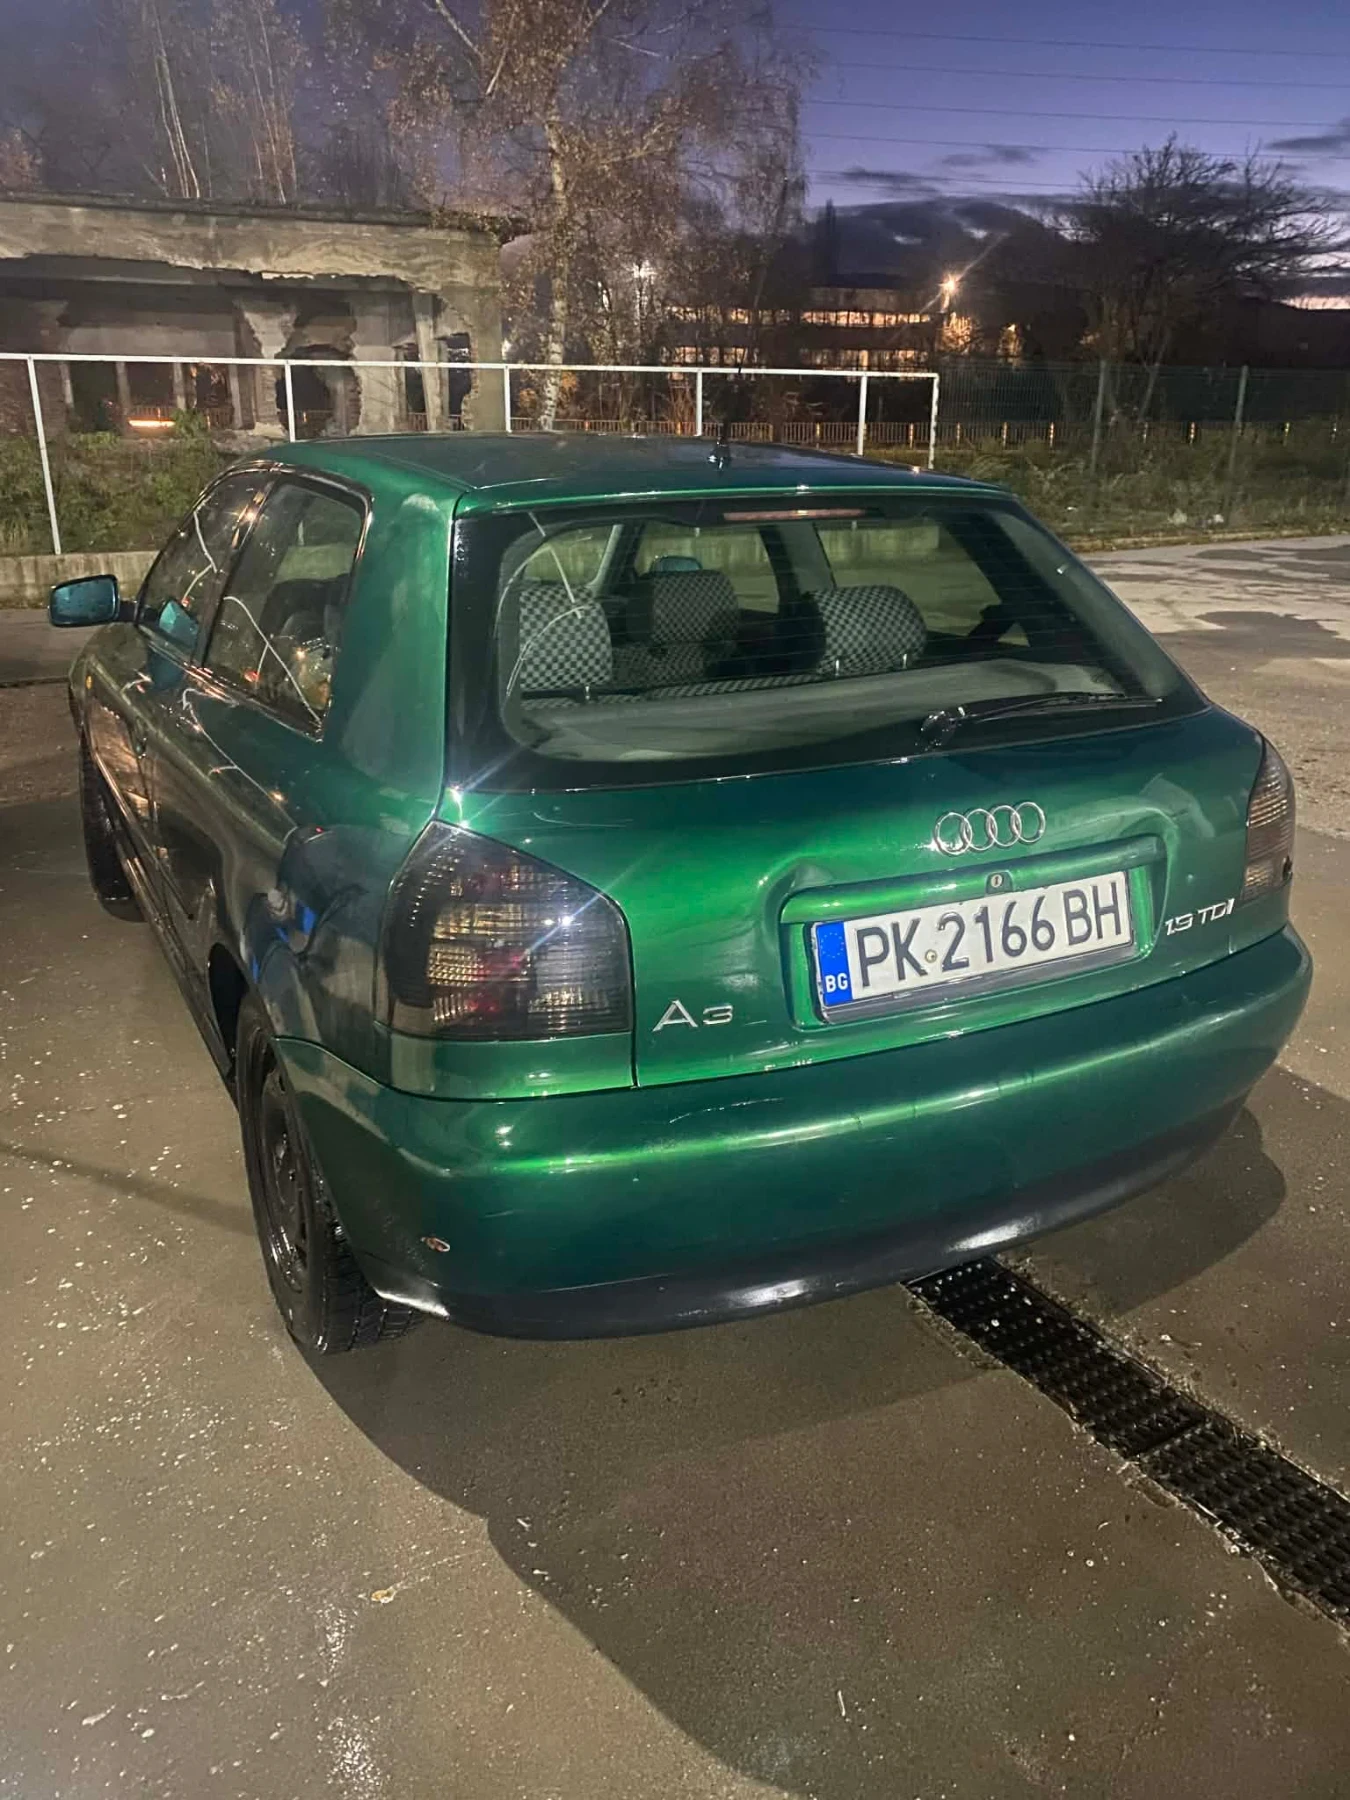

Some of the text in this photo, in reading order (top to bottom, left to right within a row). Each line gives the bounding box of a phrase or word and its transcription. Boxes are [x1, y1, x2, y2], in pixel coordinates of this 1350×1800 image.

[1197, 898, 1236, 925] TDI
[937, 896, 1056, 973] 2166
[824, 972, 849, 994] BG
[651, 999, 734, 1032] A3
